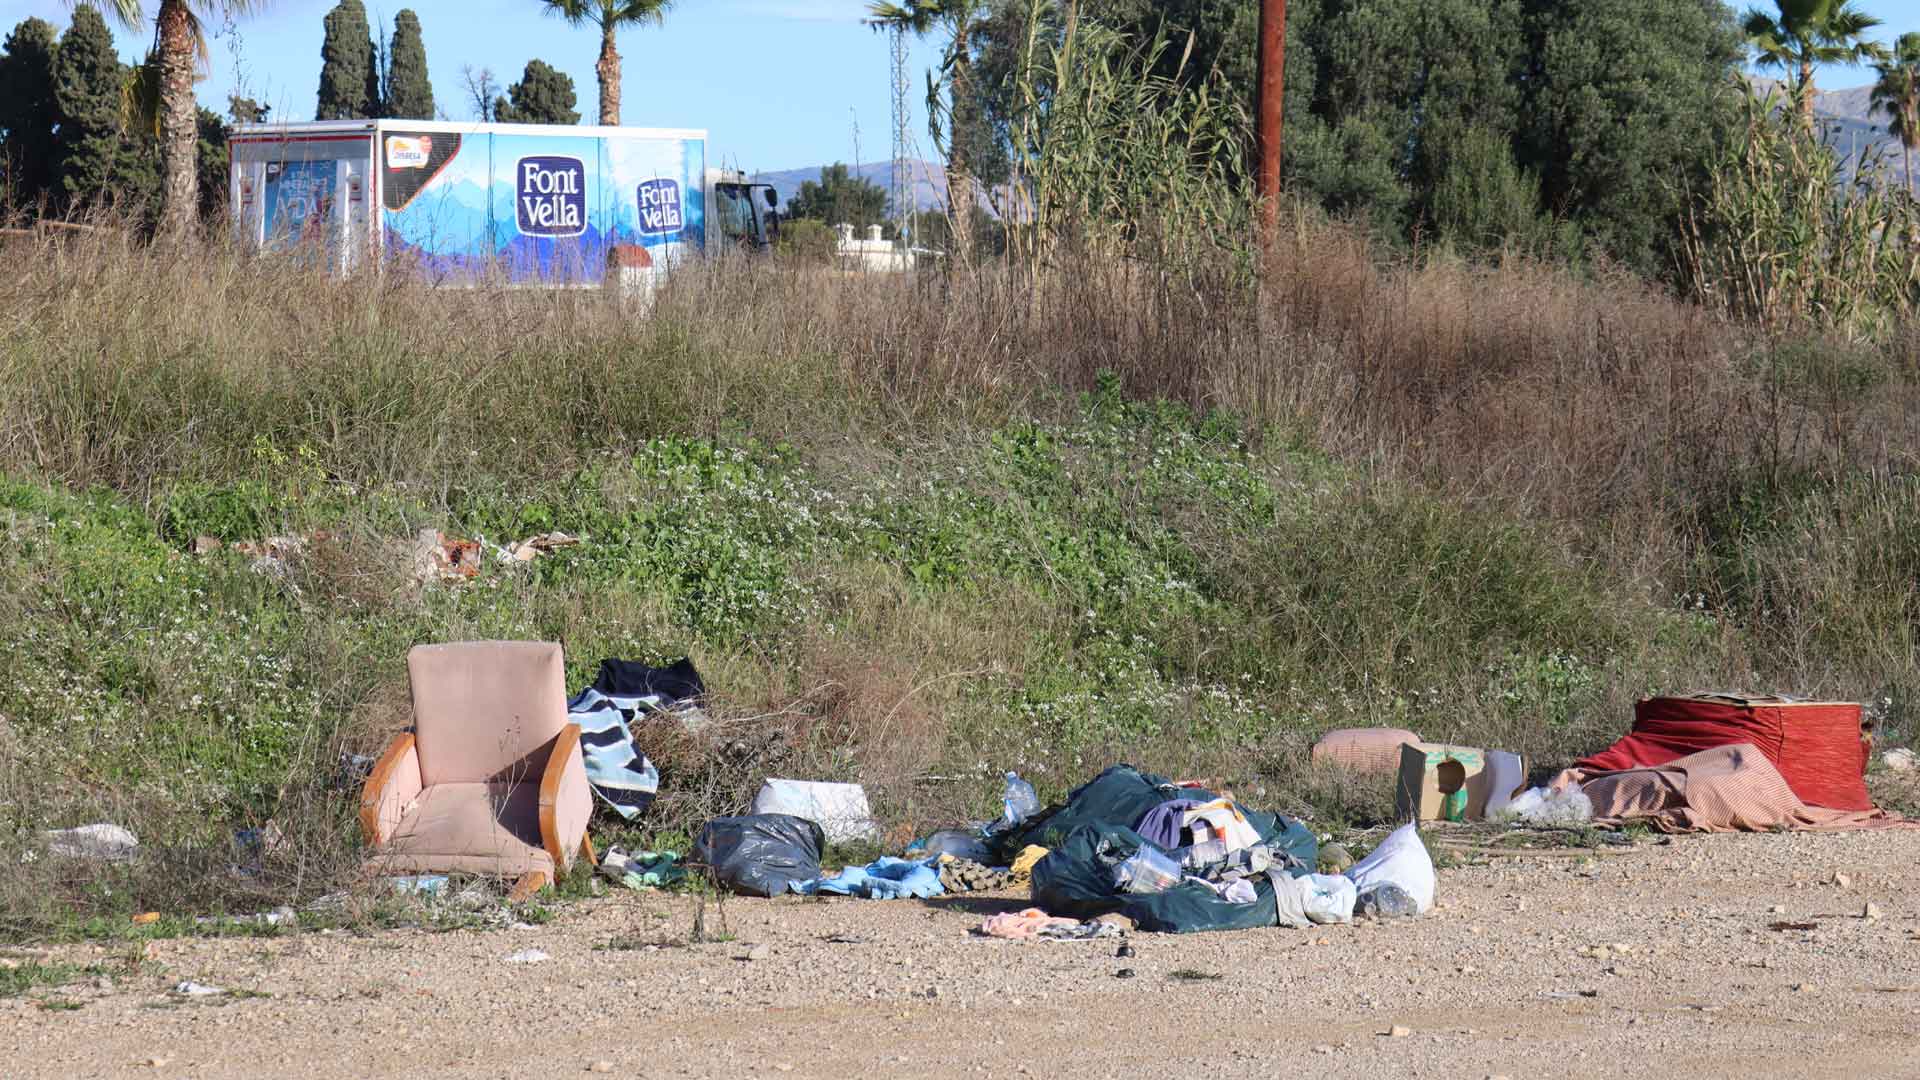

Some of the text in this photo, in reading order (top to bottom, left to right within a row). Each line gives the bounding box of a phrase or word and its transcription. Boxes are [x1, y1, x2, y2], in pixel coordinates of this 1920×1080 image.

[523, 163, 579, 194] Font
[640, 186, 677, 207] Font
[522, 194, 580, 227] Vella
[641, 204, 680, 228] Vella
